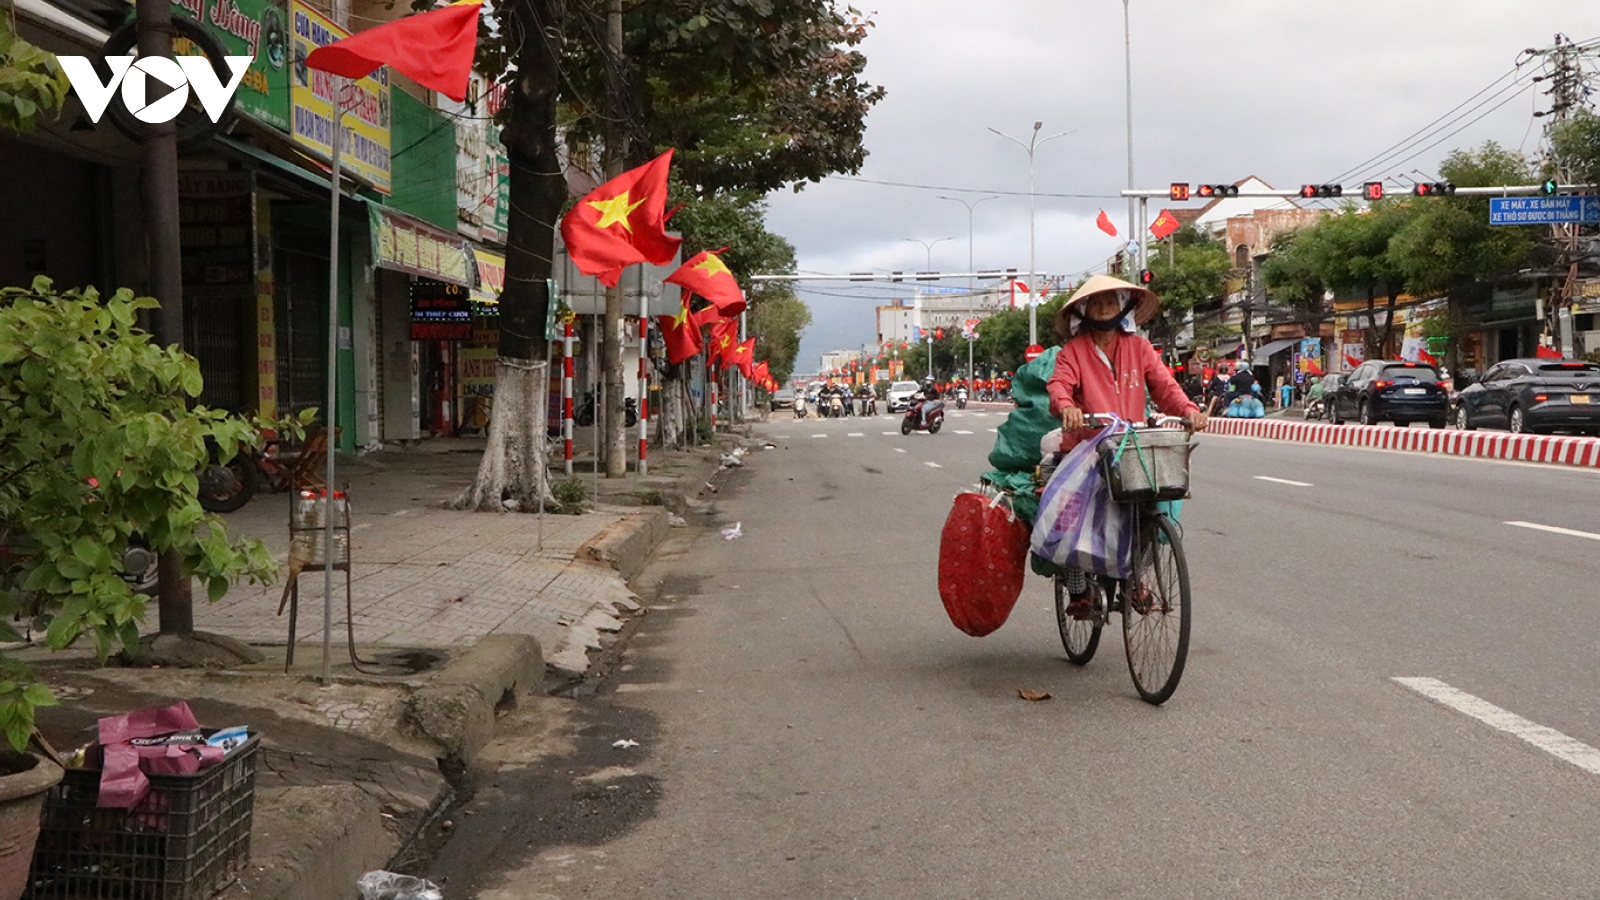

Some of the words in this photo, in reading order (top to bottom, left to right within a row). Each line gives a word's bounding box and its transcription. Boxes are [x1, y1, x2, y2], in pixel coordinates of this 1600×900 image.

[1171, 186, 1188, 199] 41
[1501, 201, 1509, 210] XE
[1530, 200, 1539, 209] XE
[1493, 213, 1501, 221] XE
